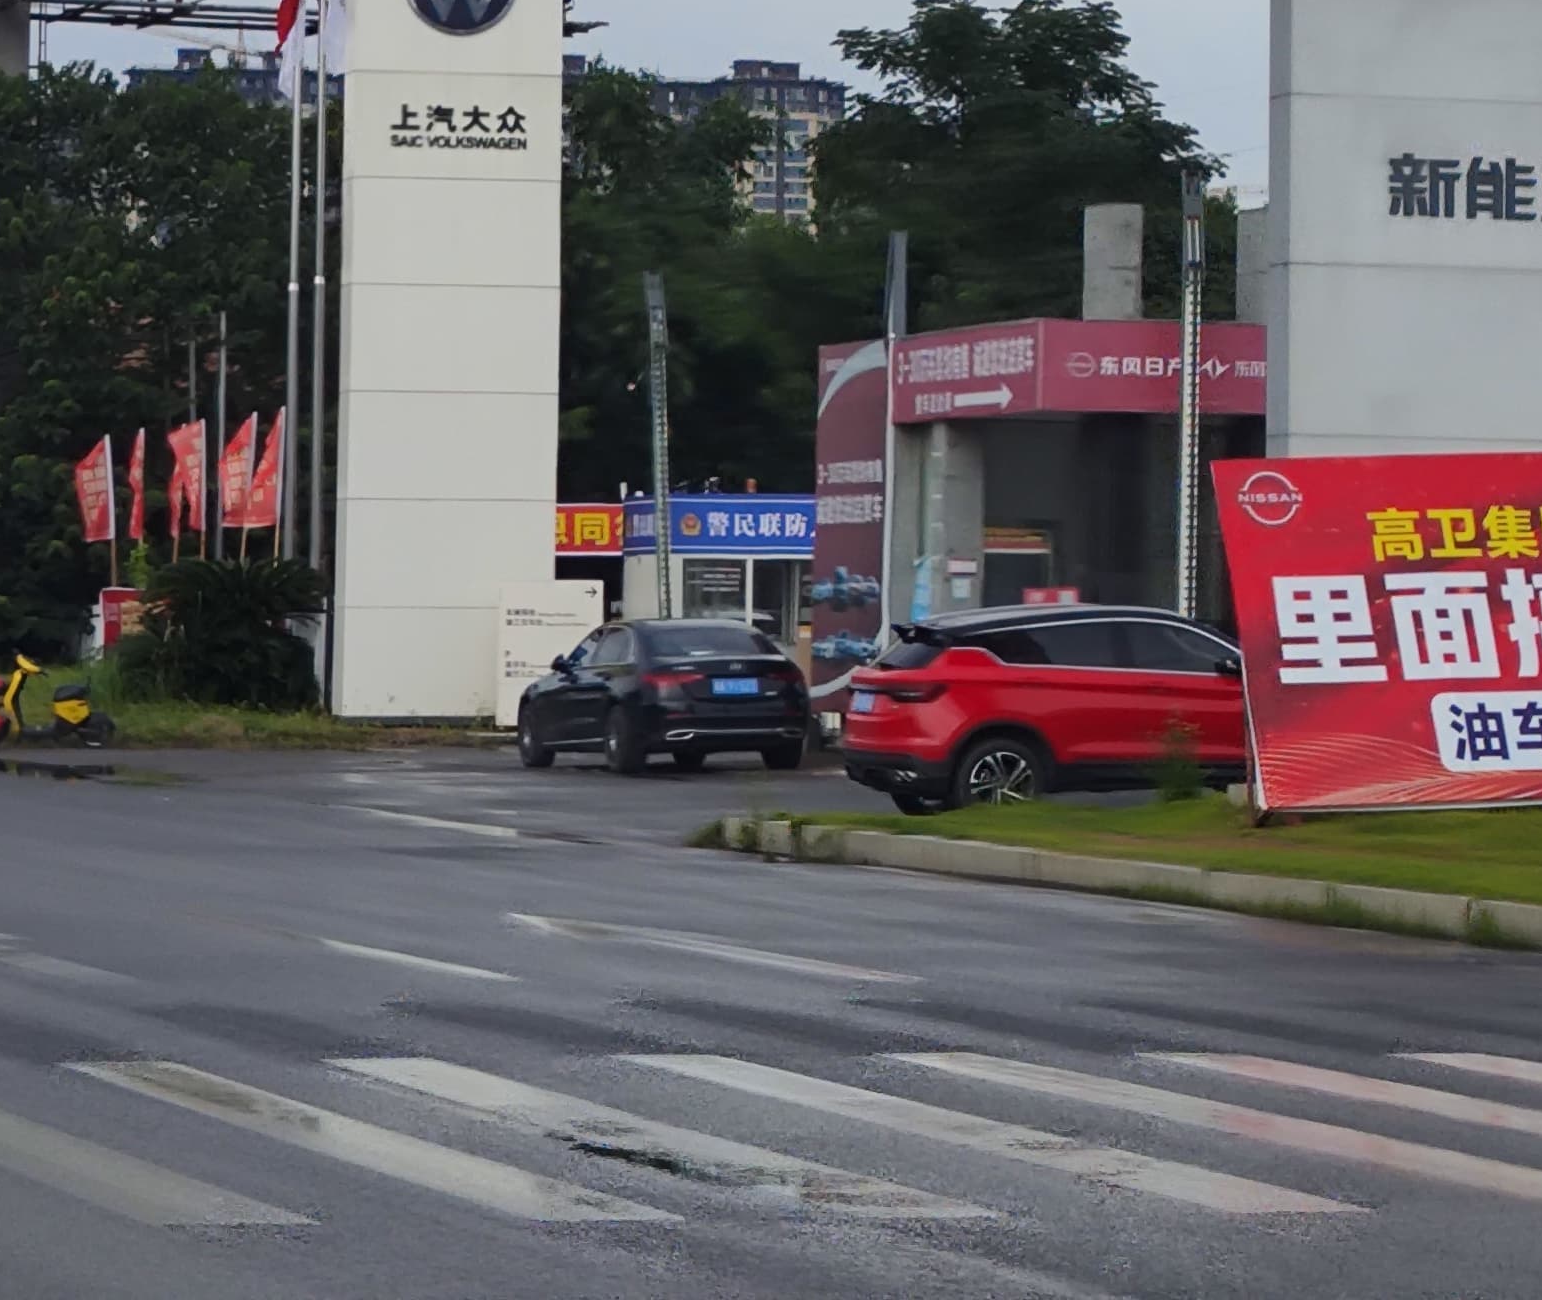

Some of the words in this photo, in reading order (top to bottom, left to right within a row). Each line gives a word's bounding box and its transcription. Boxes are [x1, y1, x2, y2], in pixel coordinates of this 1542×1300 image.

[391, 104, 527, 133] 上汽大众
[390, 135, 424, 148] SAIC
[426, 136, 527, 150] VOLKSWAGEN
[1237, 492, 1304, 503] NISSAN
